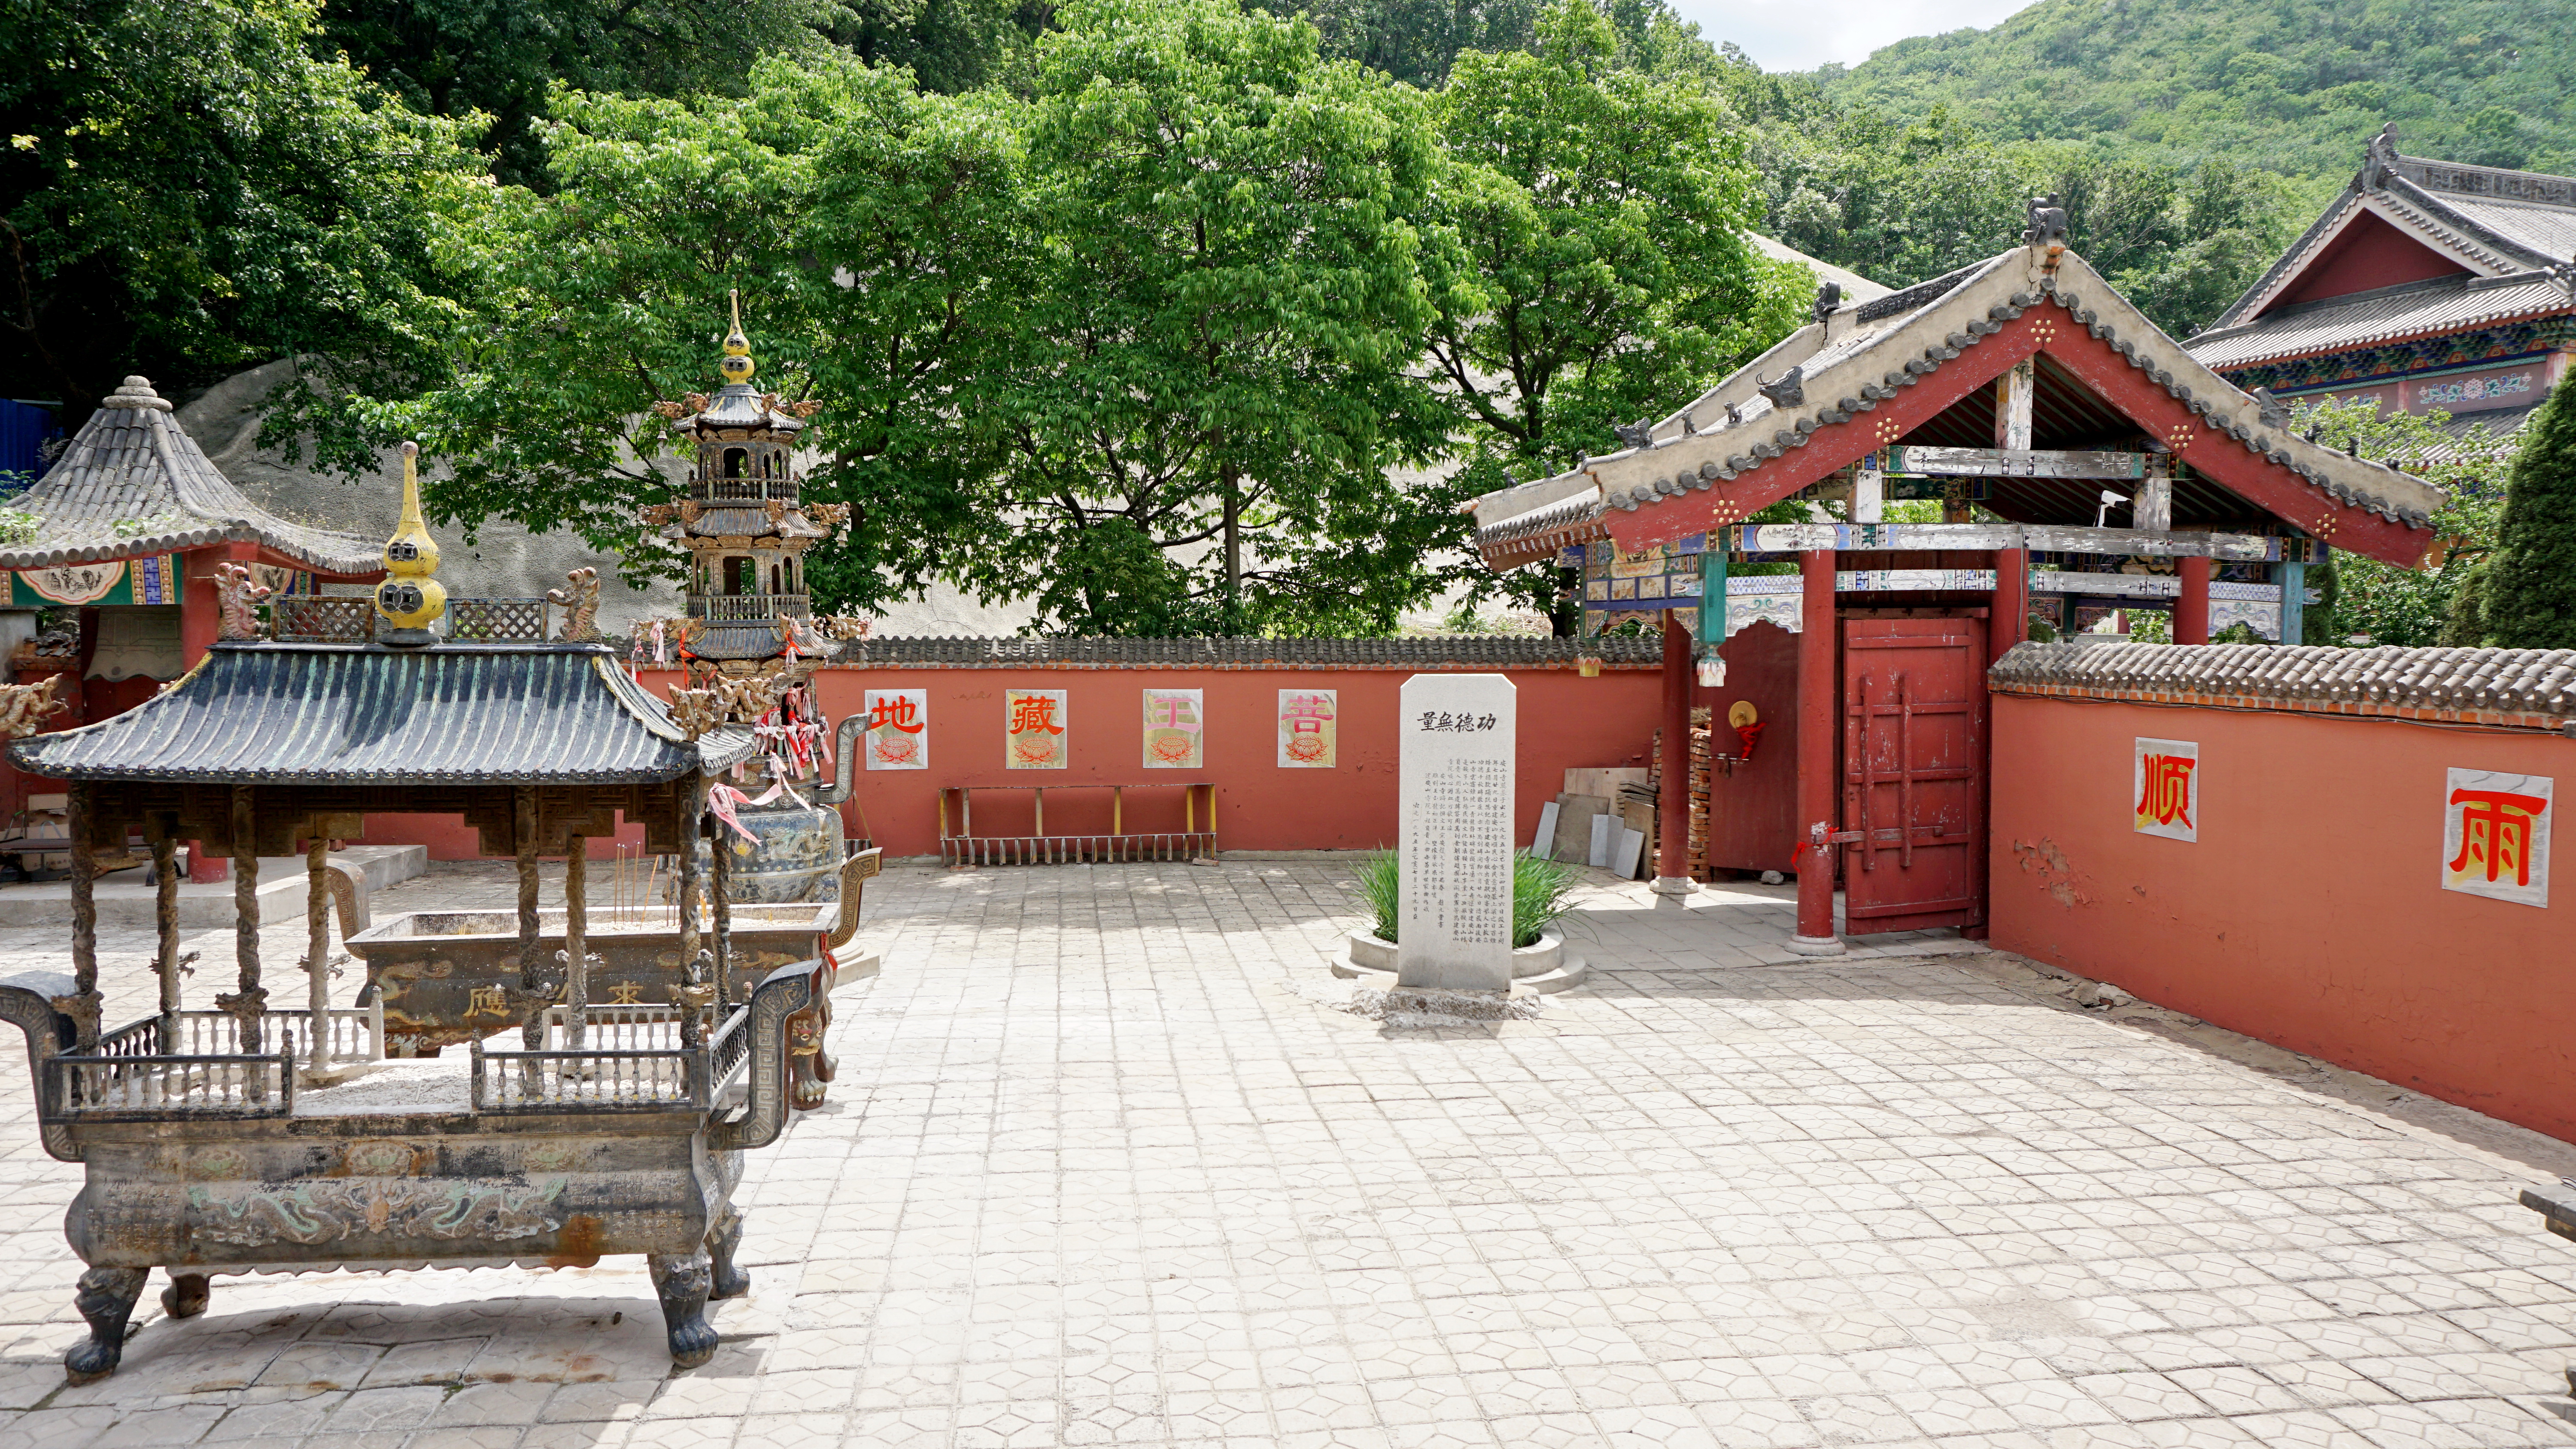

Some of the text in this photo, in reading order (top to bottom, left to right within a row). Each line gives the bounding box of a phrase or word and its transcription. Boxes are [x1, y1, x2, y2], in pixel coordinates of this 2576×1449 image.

[870, 695, 1334, 735] 地 藏 王 菩
[1417, 711, 1497, 733] 功德無量
[2137, 753, 2548, 887] 顺 雨
